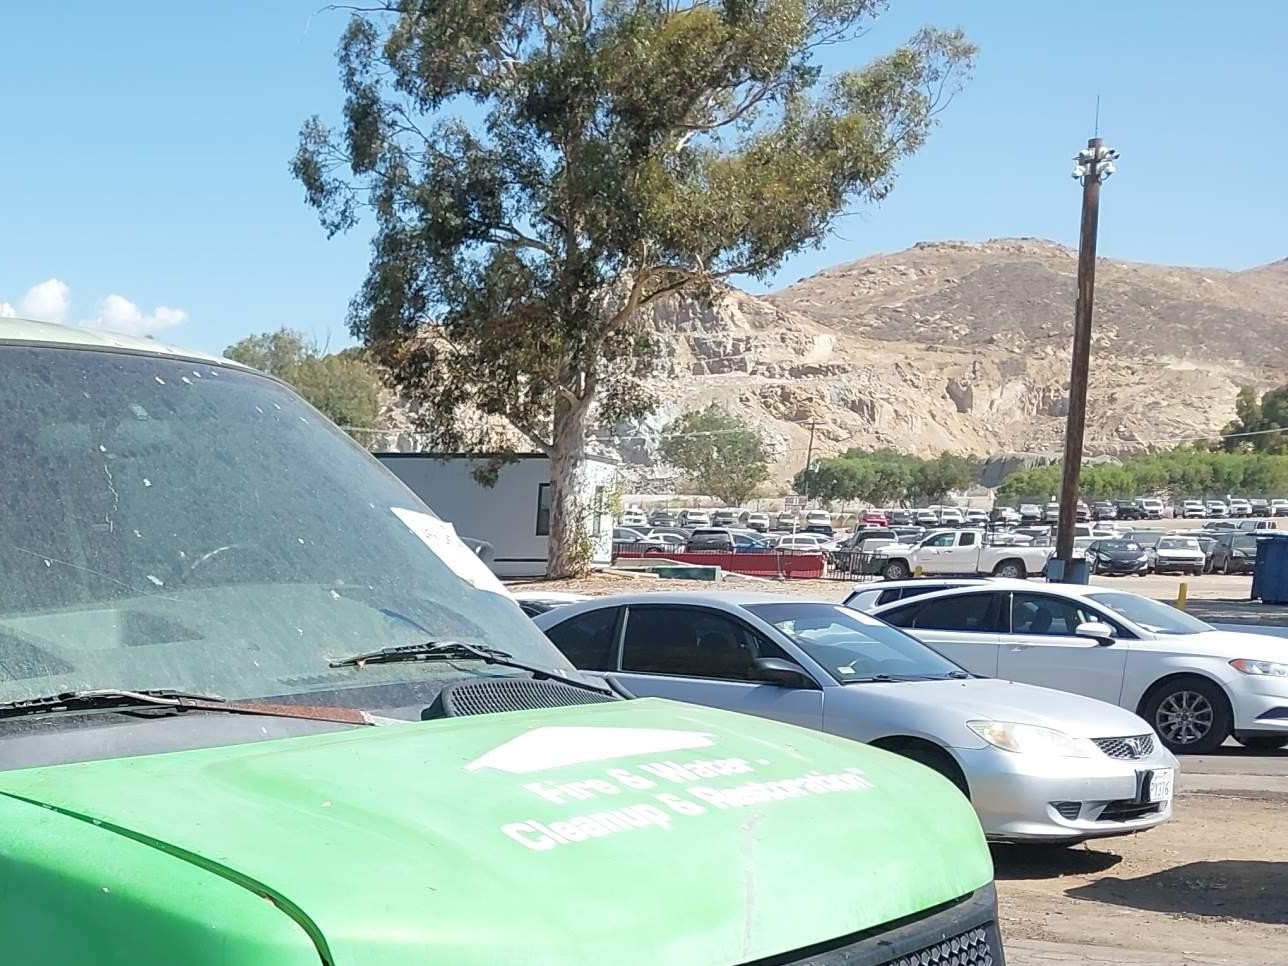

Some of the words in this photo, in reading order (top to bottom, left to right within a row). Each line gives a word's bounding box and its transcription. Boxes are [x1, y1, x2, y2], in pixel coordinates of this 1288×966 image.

[523, 778, 616, 806] Fire
[606, 768, 655, 790] &
[637, 757, 751, 783] Water
[500, 802, 672, 852] Cleanup
[654, 792, 709, 816] &
